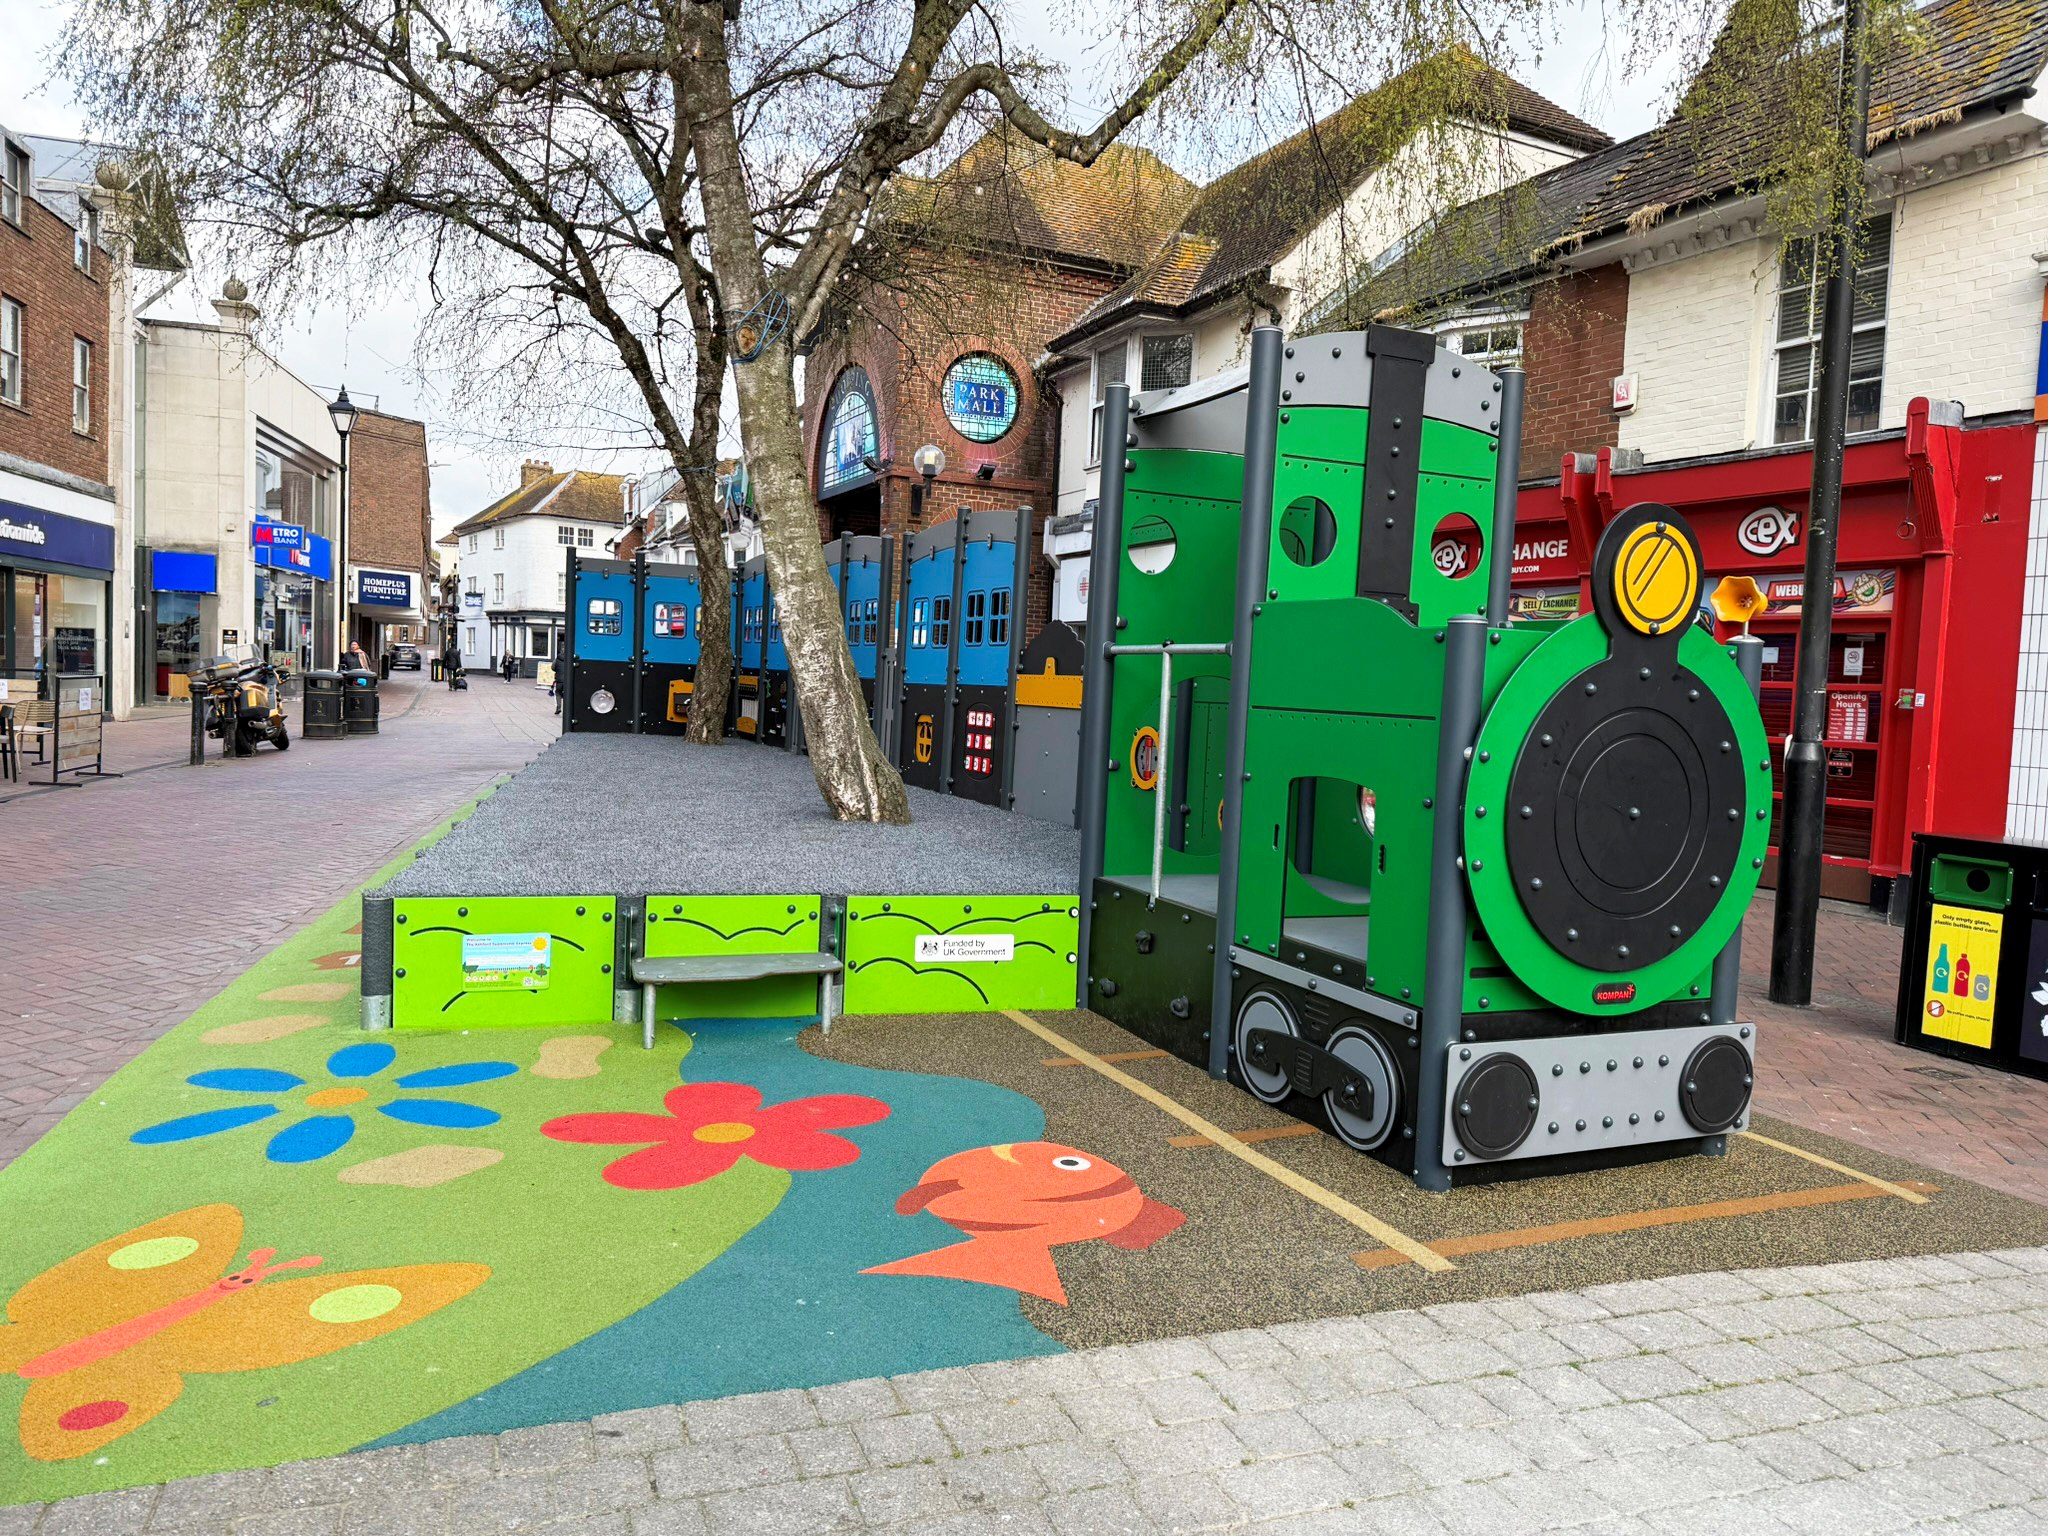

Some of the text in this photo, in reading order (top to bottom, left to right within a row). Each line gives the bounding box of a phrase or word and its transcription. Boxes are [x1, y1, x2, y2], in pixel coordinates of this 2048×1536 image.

[959, 384, 1000, 401] PARK
[957, 399, 1001, 414] MALL
[255, 526, 299, 543] METRO
[273, 536, 299, 545] BANK
[1512, 539, 1569, 561] HANGE
[363, 577, 406, 589] HOMEPLUS
[362, 585, 408, 597] FURNITURE
[1523, 598, 1578, 610] SELL EXCHANGE
[1831, 692, 1867, 702] Opening
[976, 940, 985, 948] by
